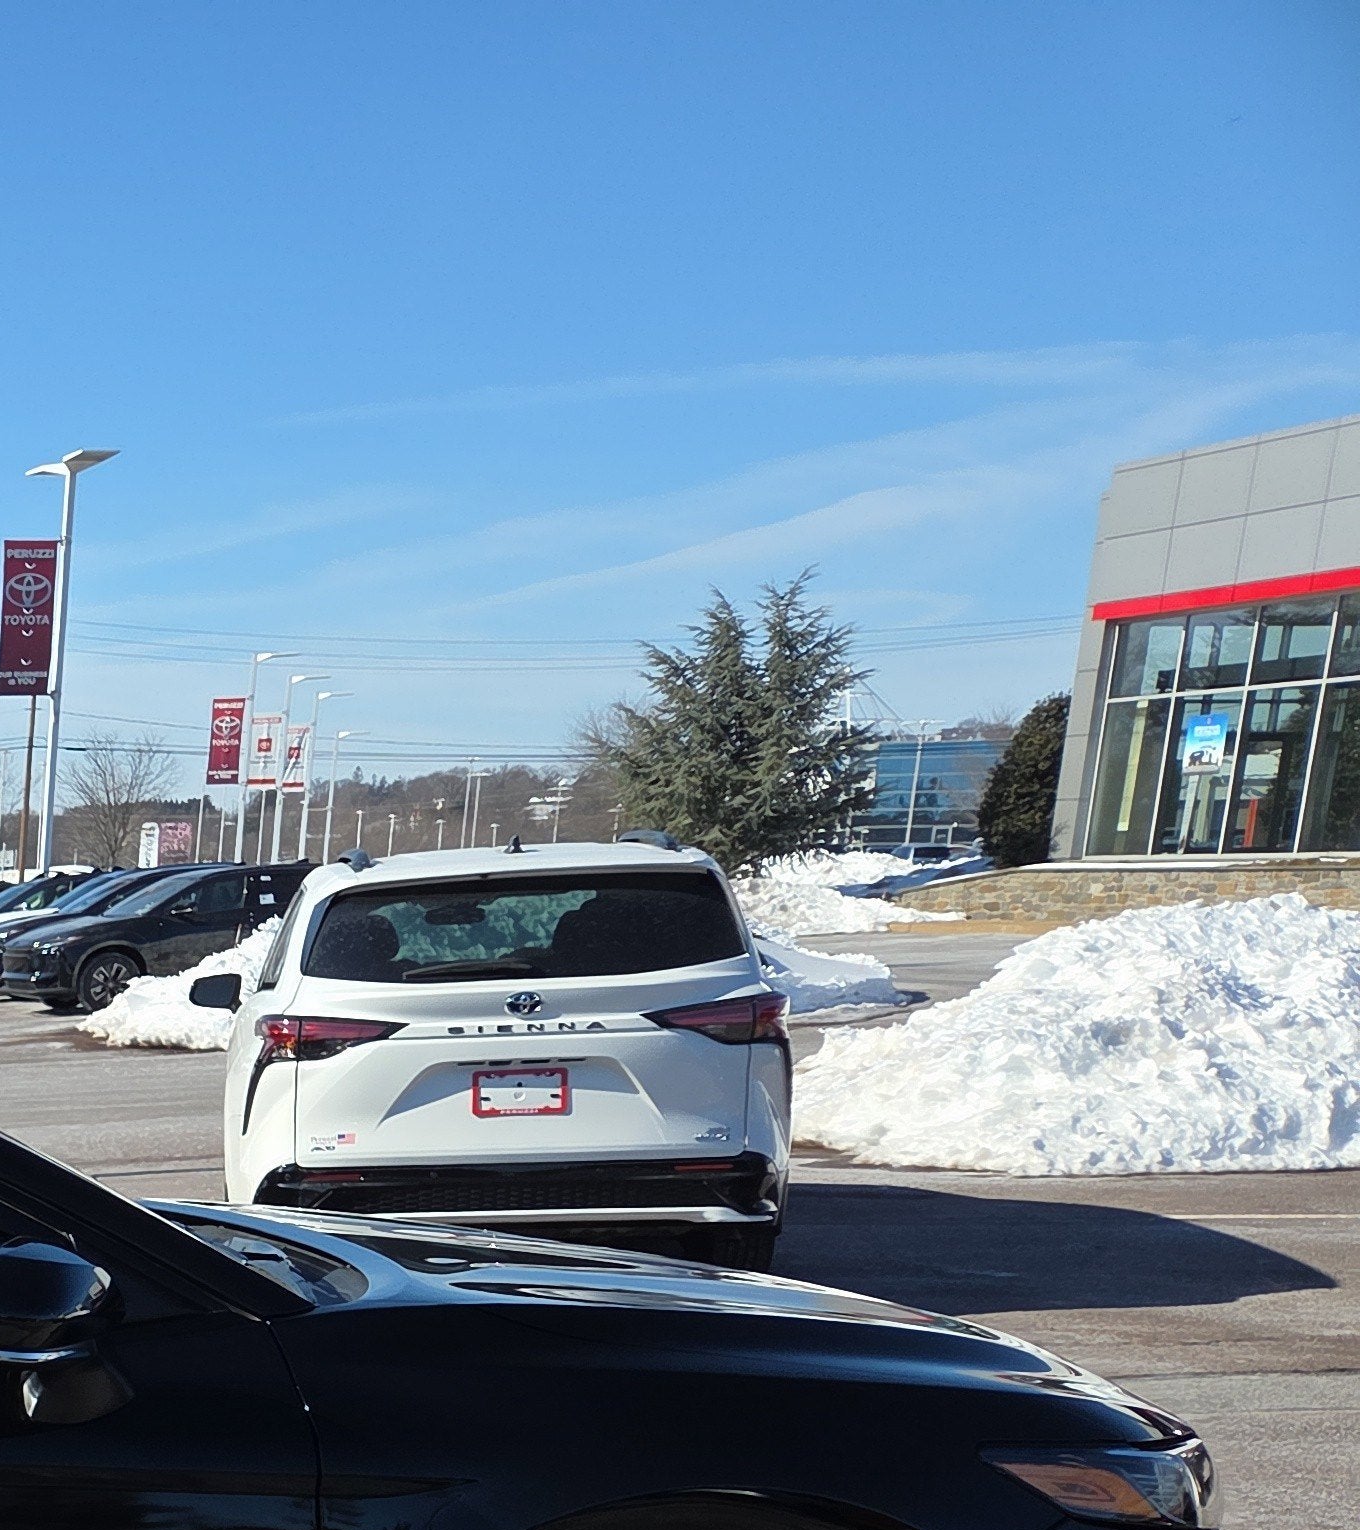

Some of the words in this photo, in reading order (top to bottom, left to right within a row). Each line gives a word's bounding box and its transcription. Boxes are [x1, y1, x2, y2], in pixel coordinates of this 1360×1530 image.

[7, 549, 55, 559] PERUZZI
[4, 615, 50, 625] TOYOTA
[447, 1021, 607, 1035] SIENNA
